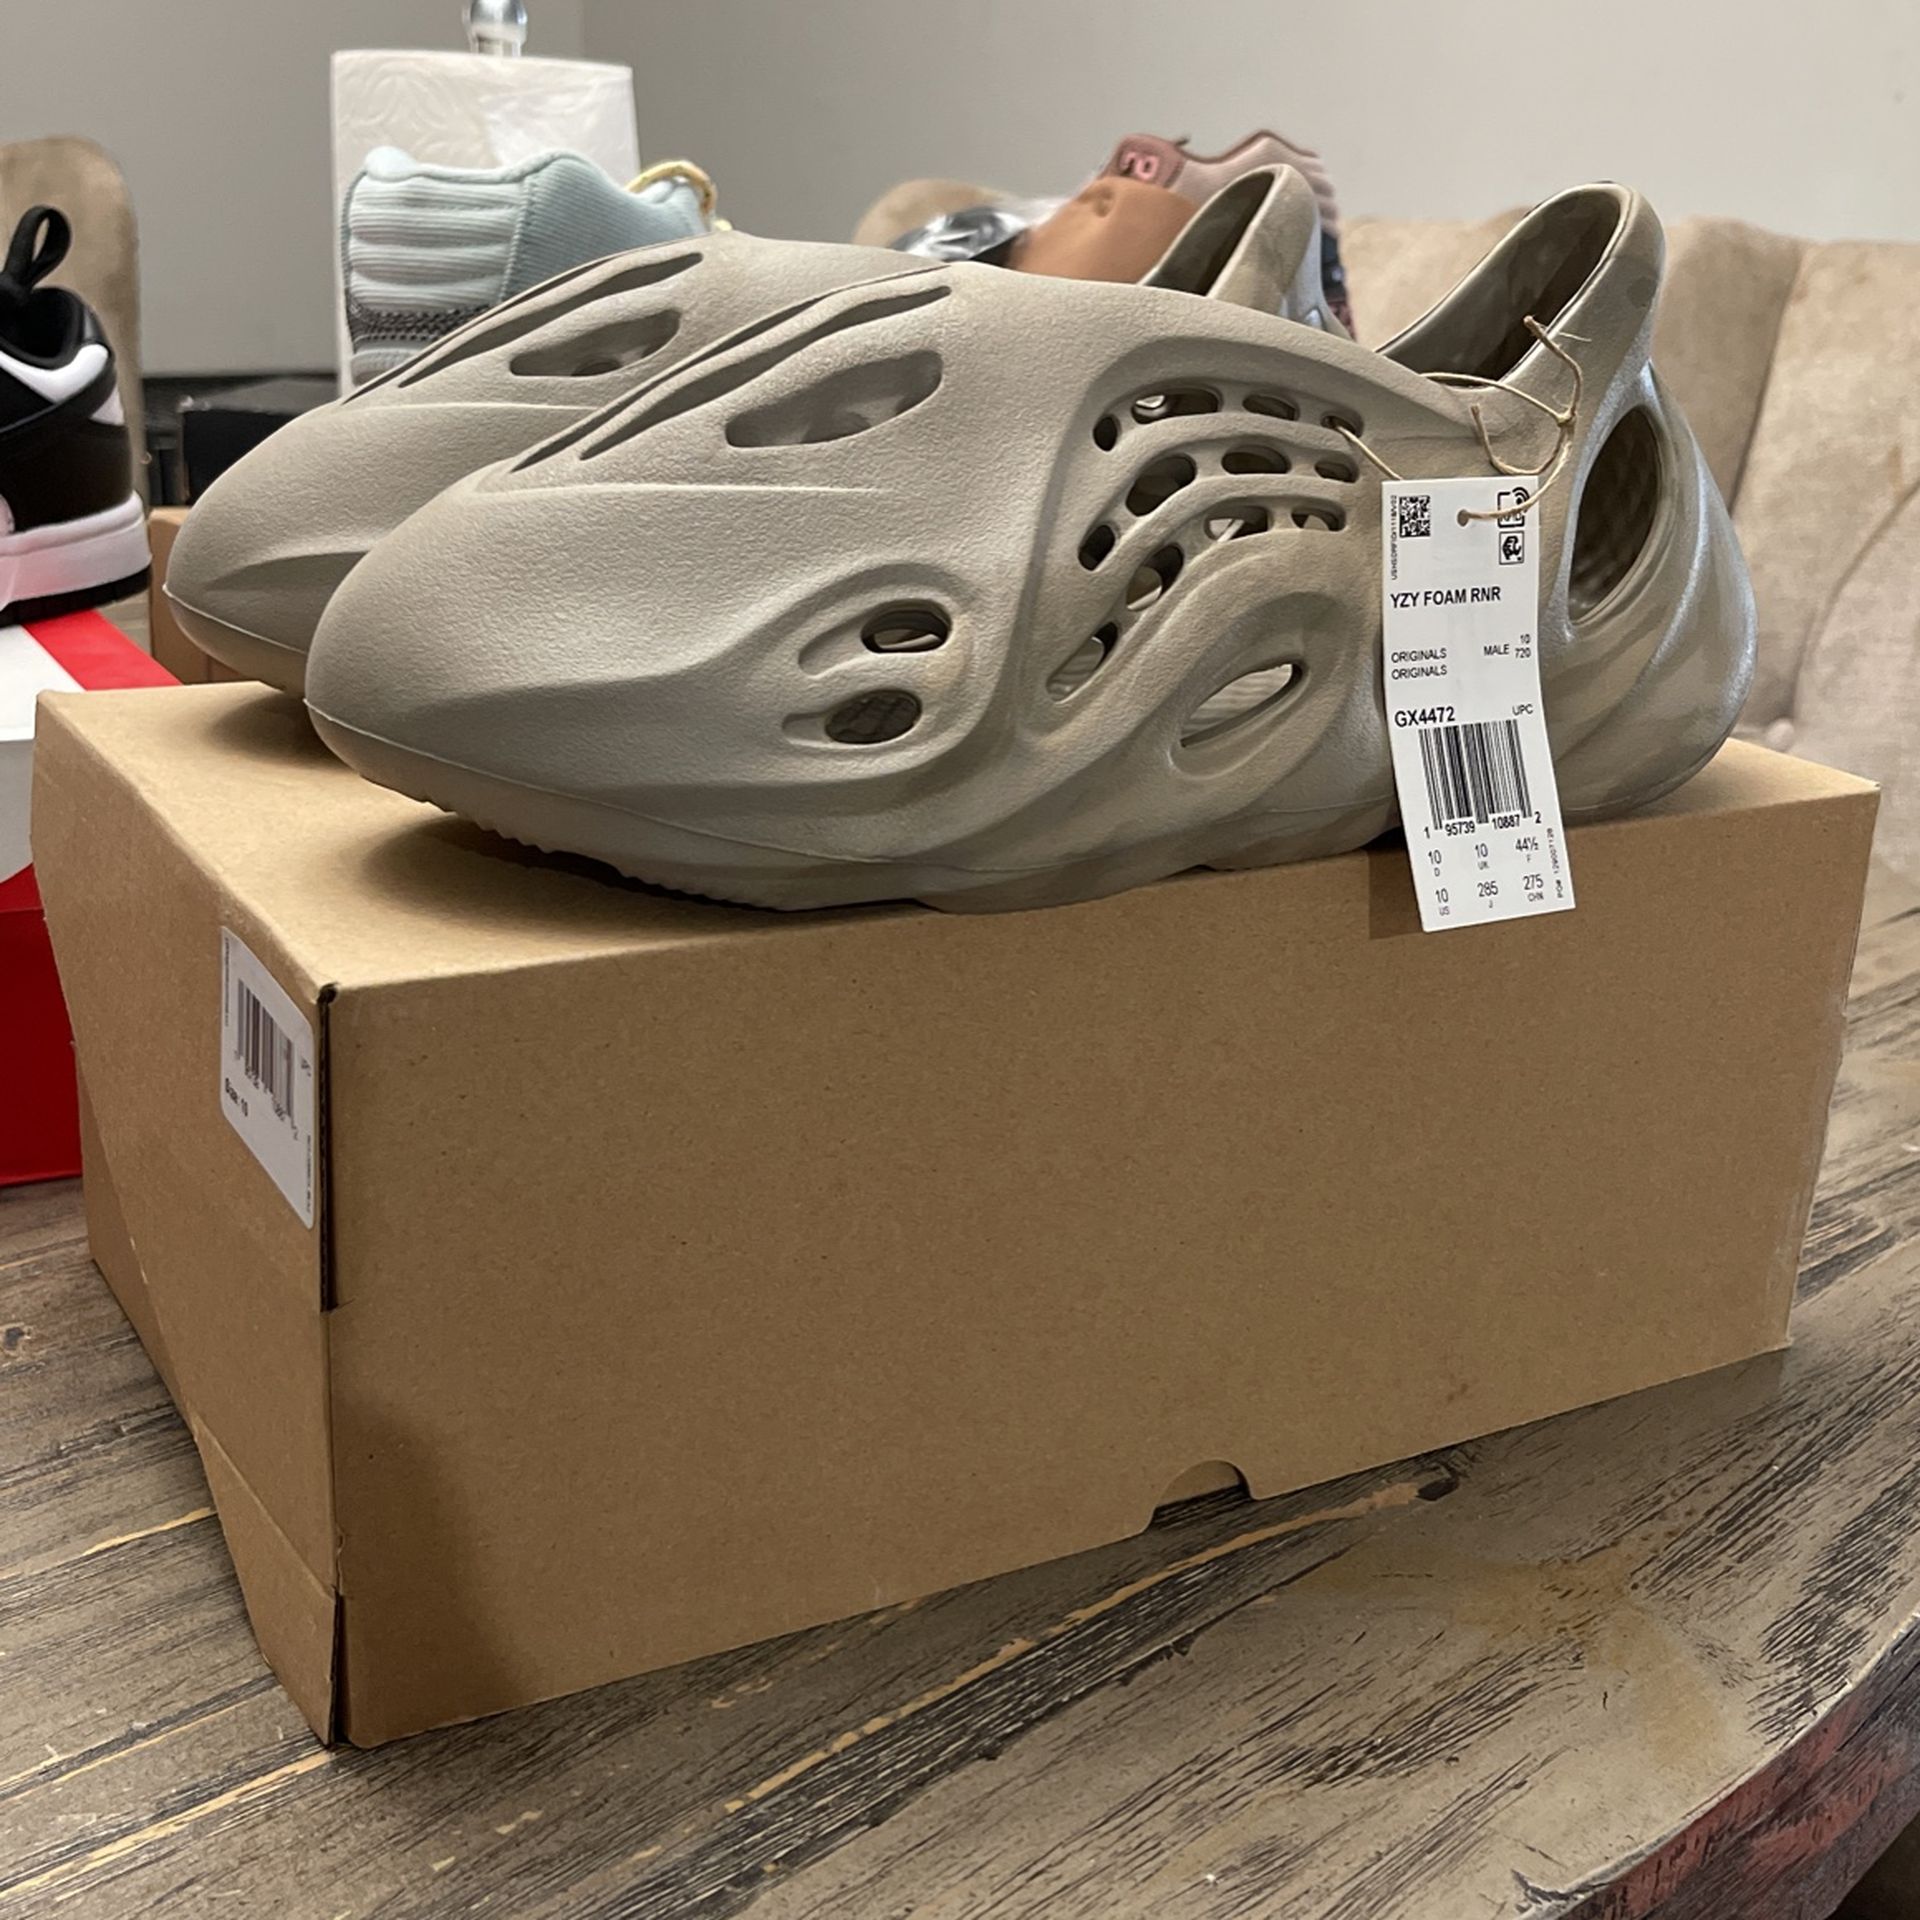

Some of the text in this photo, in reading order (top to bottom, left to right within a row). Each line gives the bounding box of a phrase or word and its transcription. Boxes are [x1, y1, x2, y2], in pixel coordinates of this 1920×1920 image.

[1391, 586, 1501, 608] YZY FOAM RNR
[1520, 634, 1531, 644] 10
[1391, 648, 1447, 663] ORIGINALS
[1484, 644, 1510, 656] MALE
[1515, 647, 1531, 658] 720
[1391, 665, 1448, 680] ORIGINALS
[1394, 706, 1456, 727] GX4472
[1512, 704, 1534, 716] UPC
[1424, 811, 1542, 839] 1 95739 10887 2
[1428, 850, 1442, 865] 10
[1474, 843, 1489, 859] 10
[1435, 874, 1544, 904] 10 285 275
[1439, 906, 1450, 916] US
